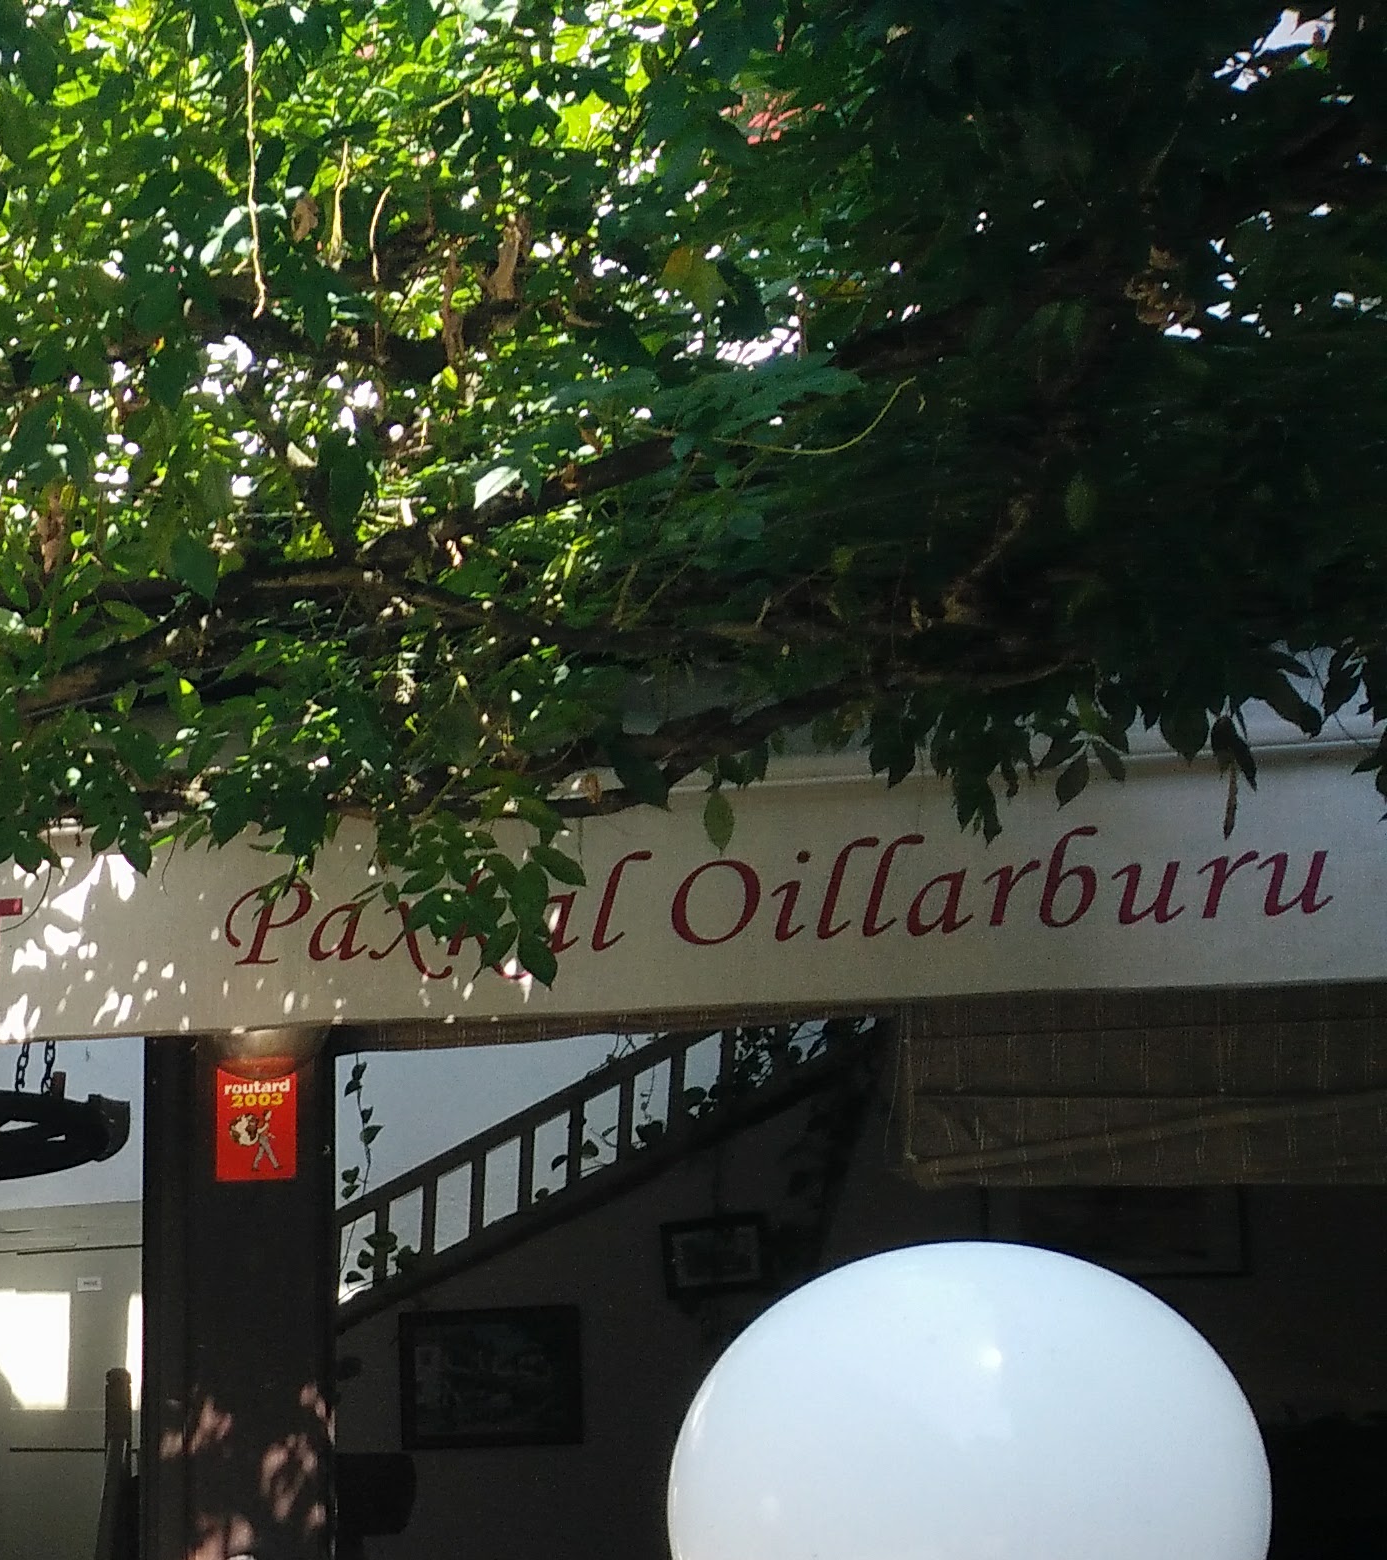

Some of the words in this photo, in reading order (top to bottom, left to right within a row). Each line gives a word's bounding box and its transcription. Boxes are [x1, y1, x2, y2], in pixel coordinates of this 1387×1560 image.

[670, 825, 1334, 946] Oillarburu
[224, 1079, 290, 1095] routard
[231, 1092, 283, 1107] 2003
